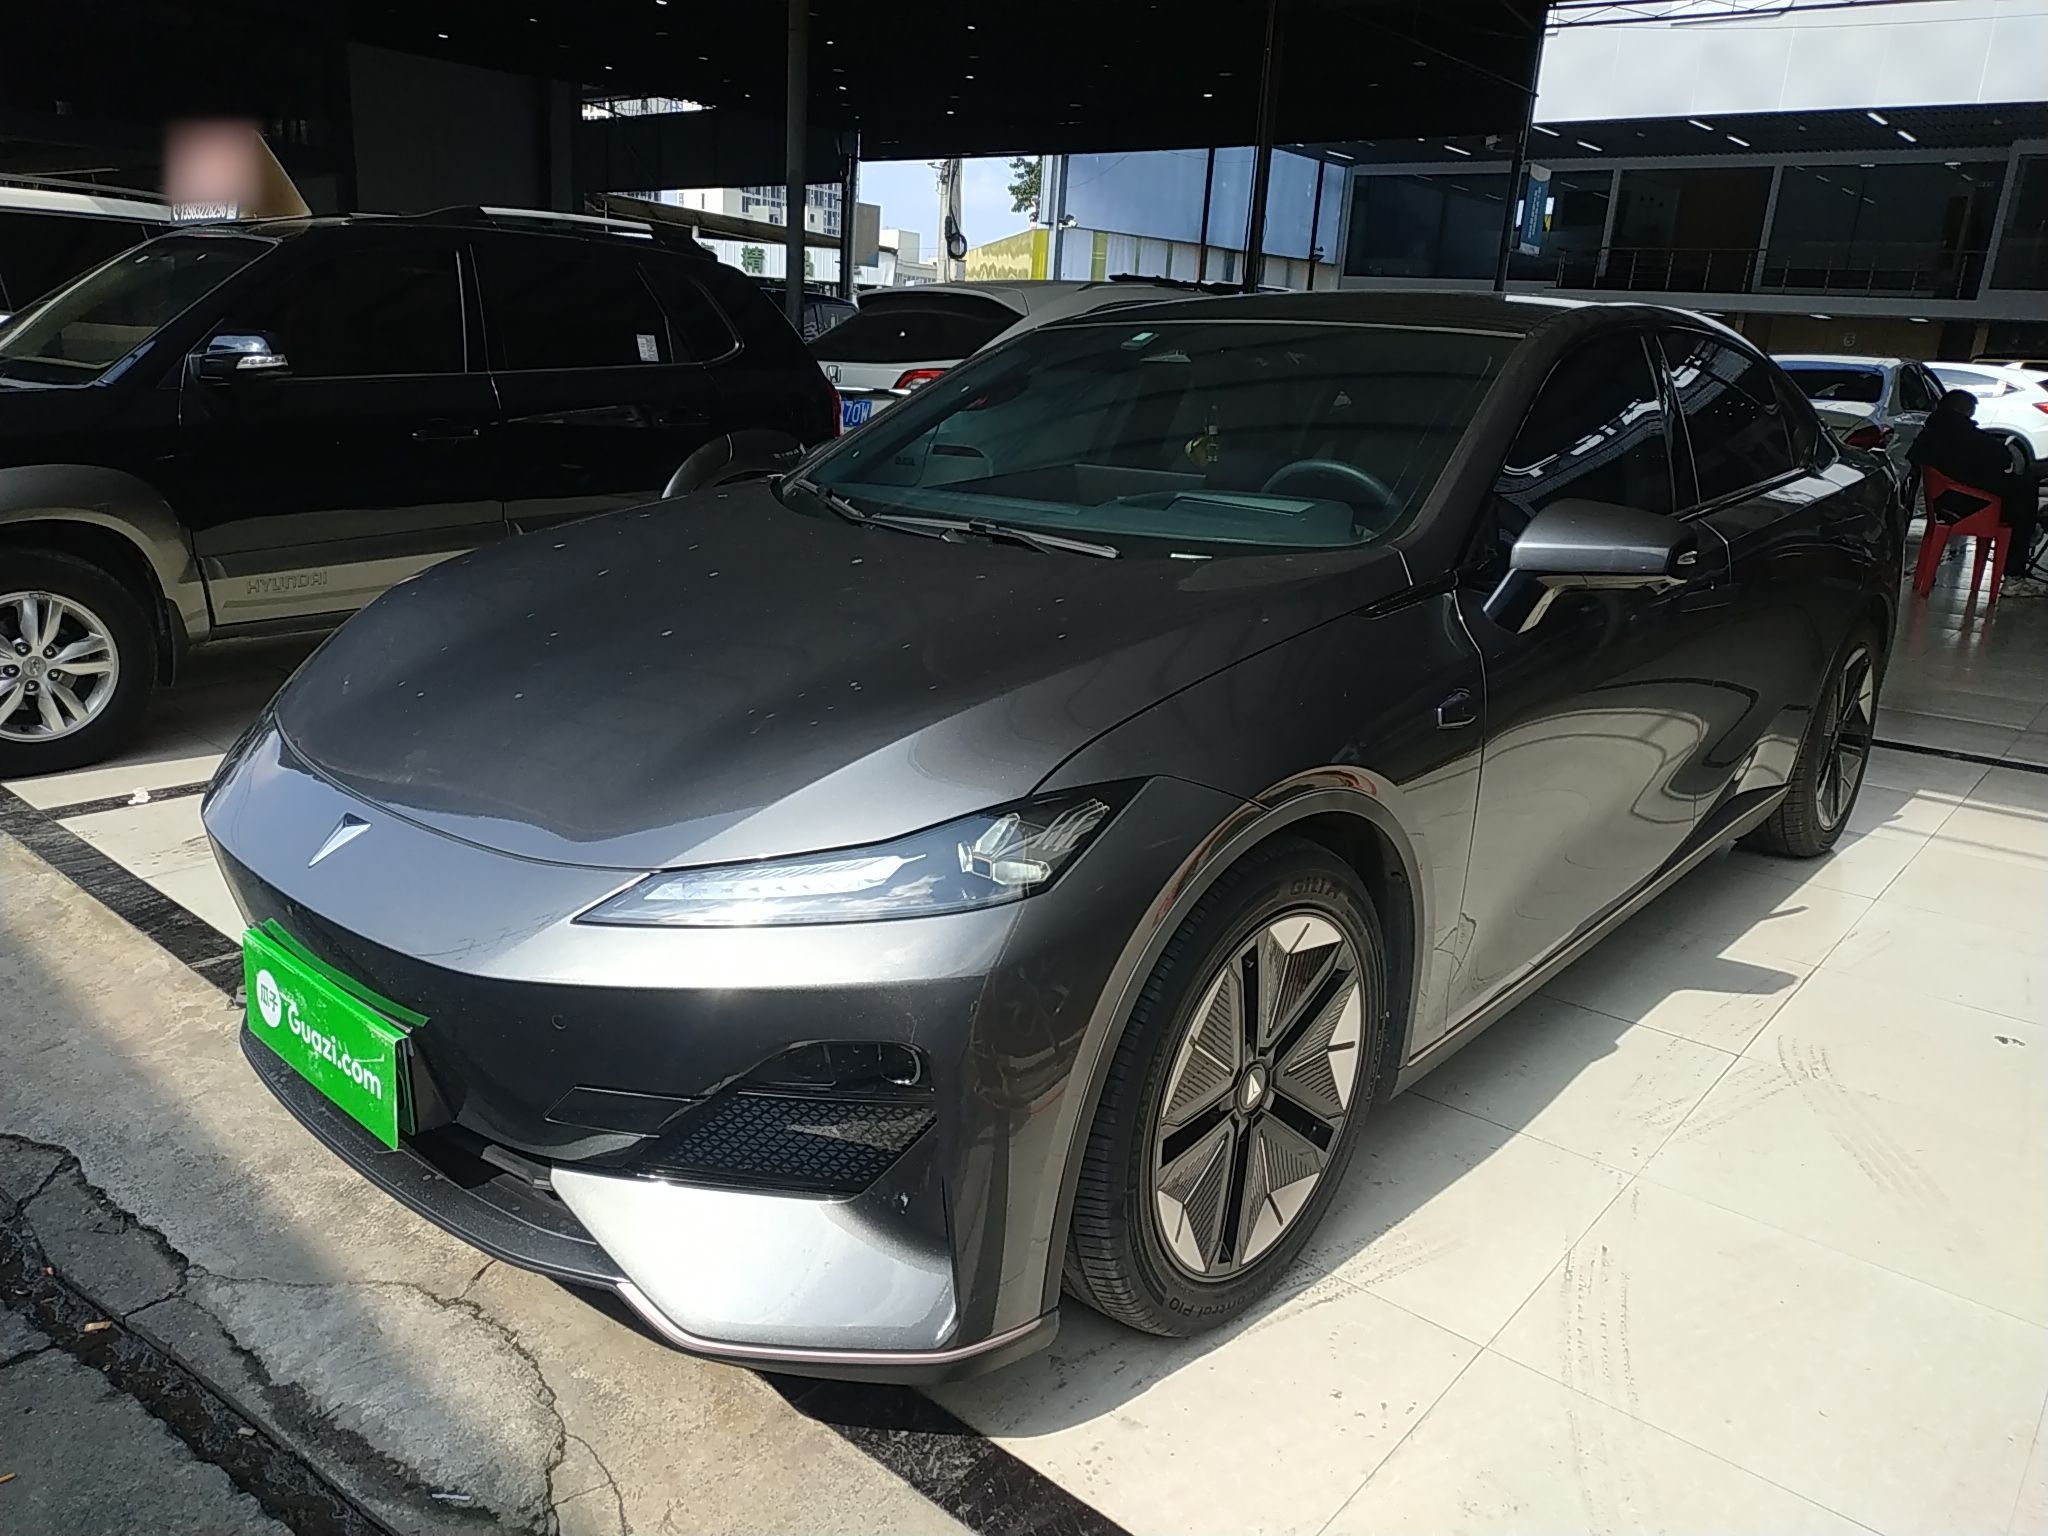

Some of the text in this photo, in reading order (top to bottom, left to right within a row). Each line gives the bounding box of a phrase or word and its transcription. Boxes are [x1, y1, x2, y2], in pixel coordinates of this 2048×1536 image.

[841, 402, 870, 423] 70W
[247, 571, 327, 594] HYUNDAI
[260, 983, 279, 1013] 瓜子
[287, 1002, 382, 1100] Guazi.com
